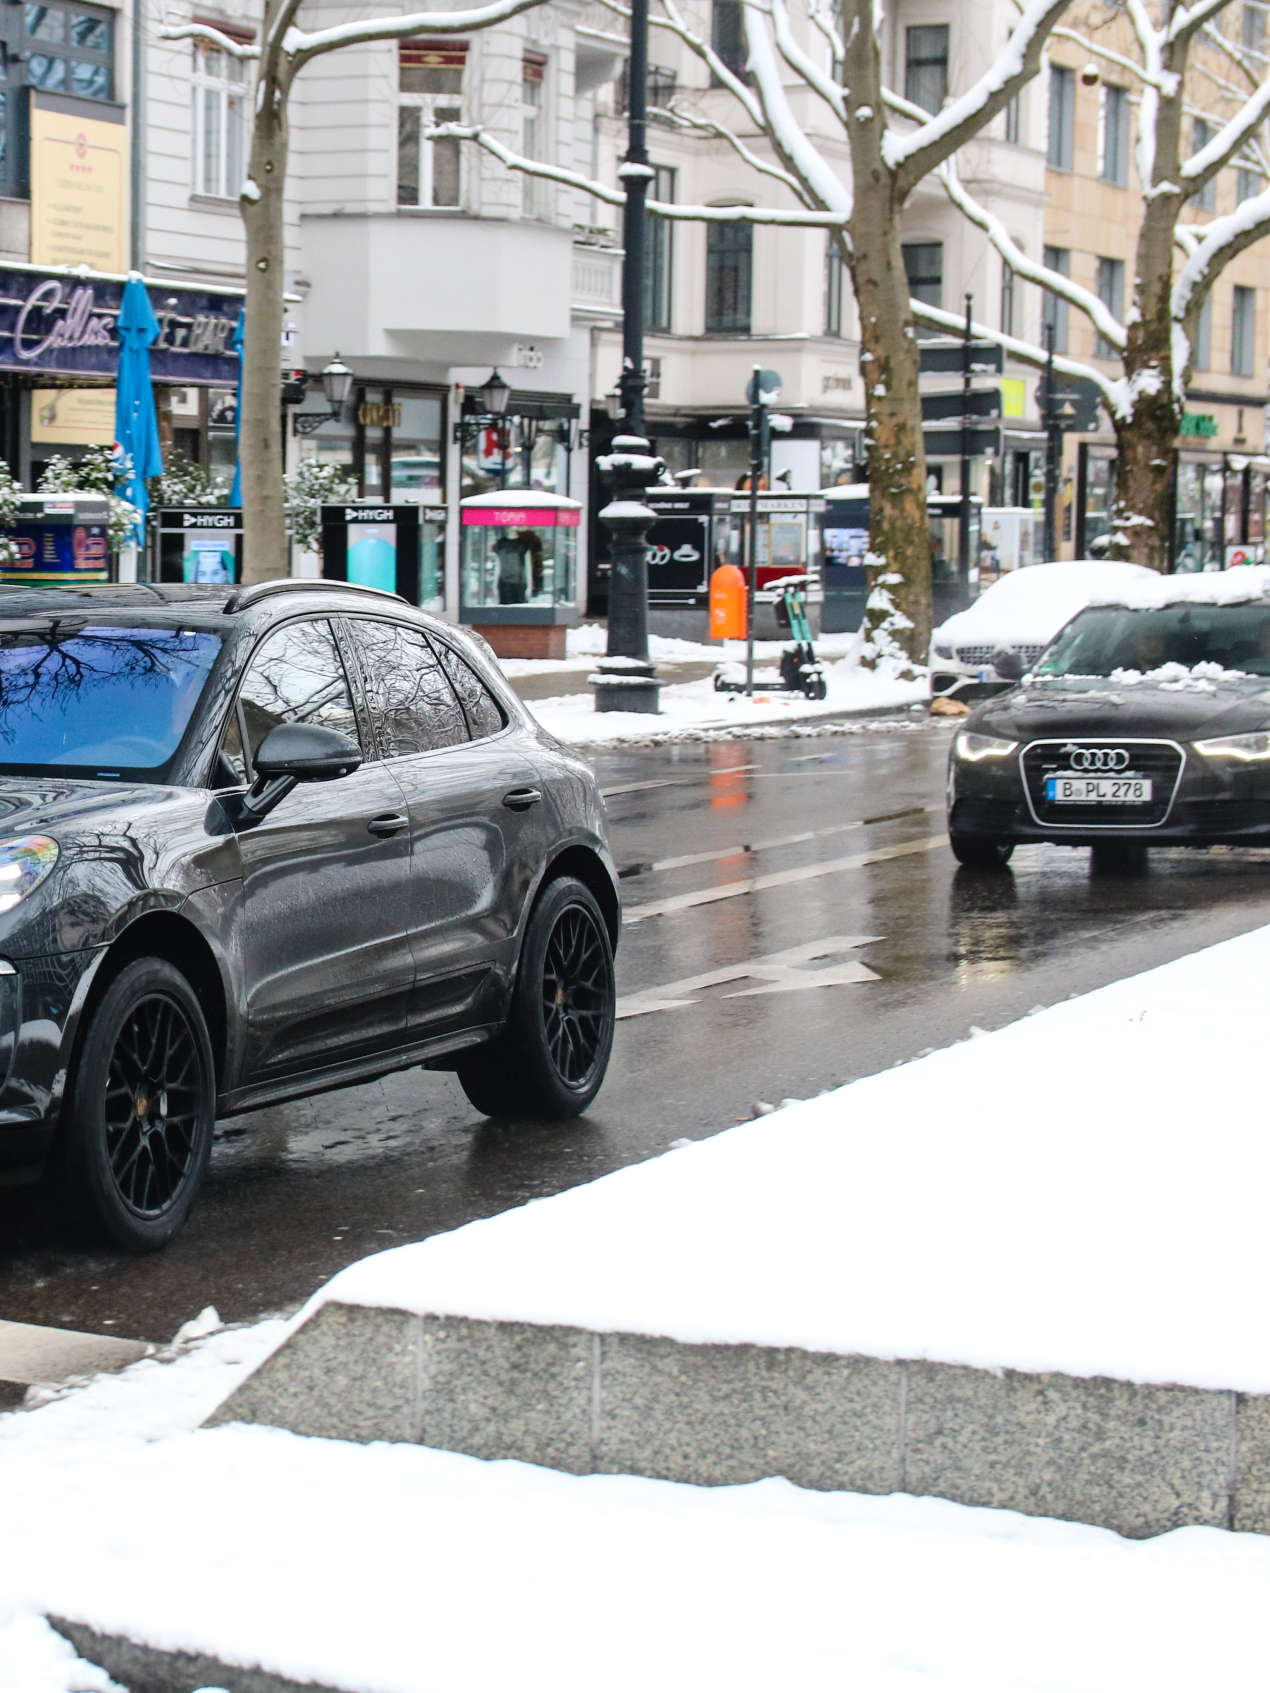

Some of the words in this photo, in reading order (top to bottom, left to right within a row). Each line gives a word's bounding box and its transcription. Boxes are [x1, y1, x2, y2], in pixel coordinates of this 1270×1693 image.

[196, 515, 234, 527] HYGH
[358, 509, 394, 521] HYGH
[1062, 782, 1074, 798] B
[1085, 782, 1106, 798] PL
[1111, 782, 1143, 798] 278
